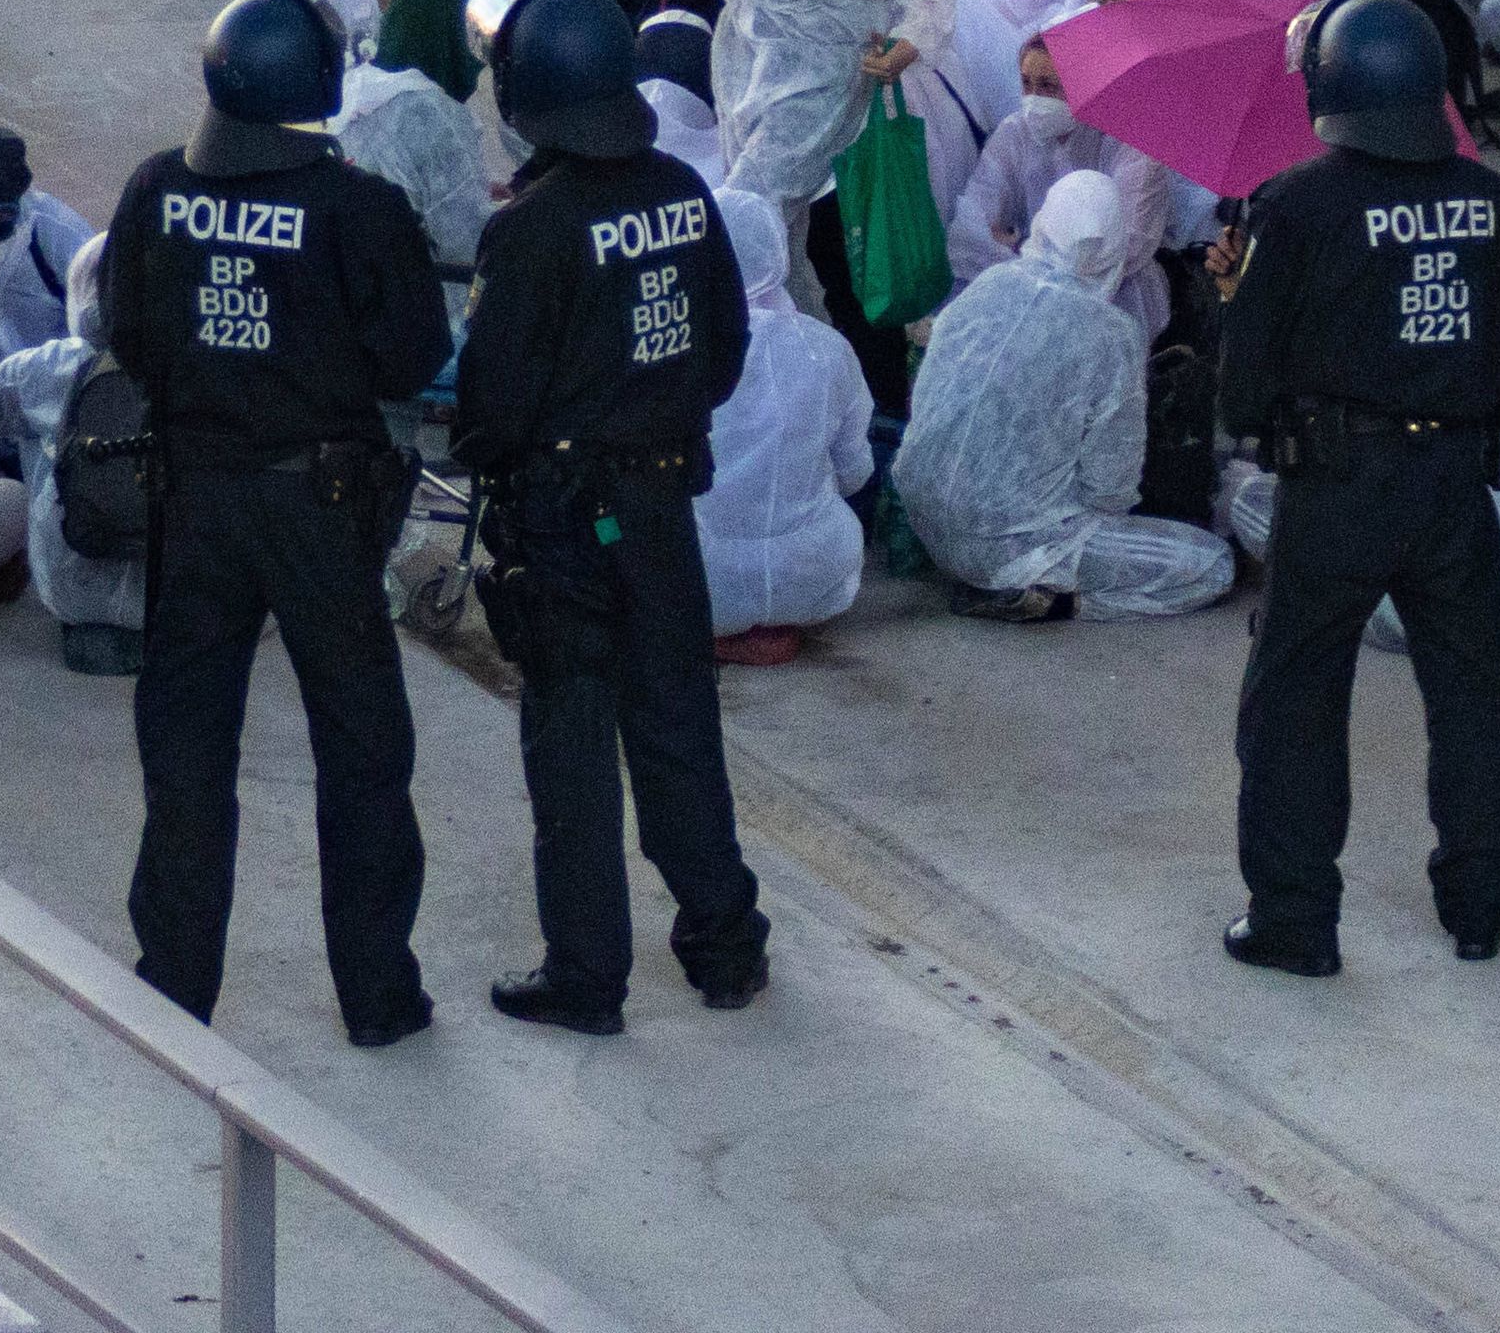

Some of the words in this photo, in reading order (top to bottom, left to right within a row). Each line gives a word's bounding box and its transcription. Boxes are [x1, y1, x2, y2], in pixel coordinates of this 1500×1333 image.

[163, 193, 305, 249] POLIZEI
[591, 197, 708, 265] POLIZEI
[1365, 199, 1496, 247] POLIZEI
[211, 255, 255, 285] BP
[640, 265, 678, 301] BP
[1413, 251, 1458, 282] BP
[199, 285, 269, 318] BDÜ
[633, 291, 689, 334] BDÜ
[1401, 279, 1470, 314] BDÜ
[199, 317, 271, 350] 4220
[632, 323, 692, 364] 4222
[1401, 311, 1472, 343] 4221
